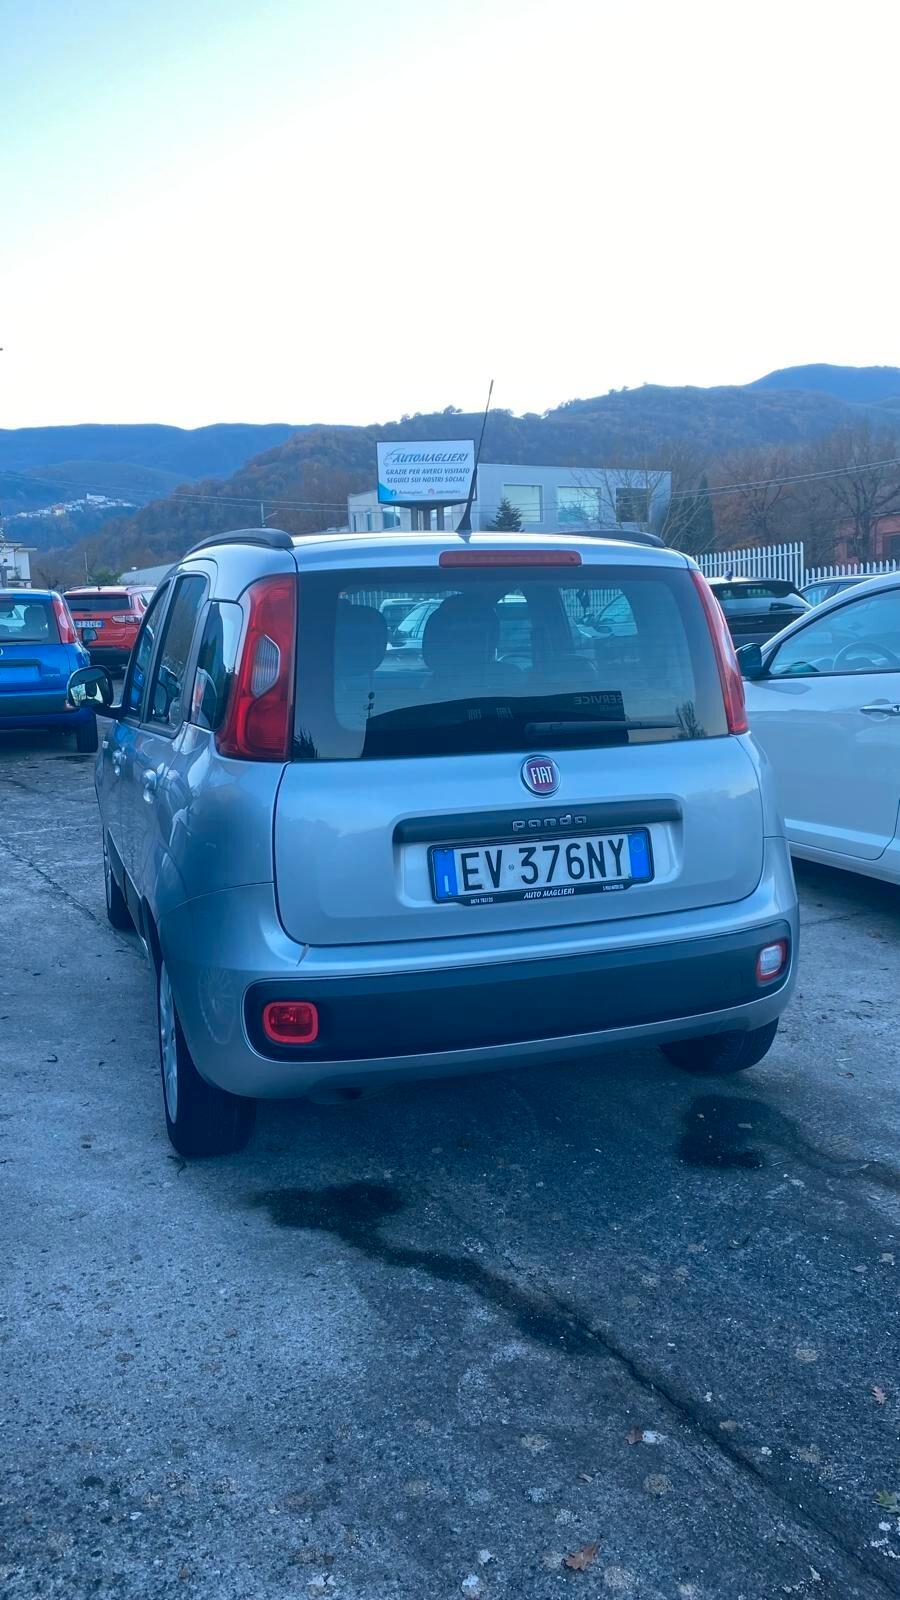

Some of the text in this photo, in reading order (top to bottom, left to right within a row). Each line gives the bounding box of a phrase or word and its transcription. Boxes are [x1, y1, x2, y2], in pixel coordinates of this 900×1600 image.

[392, 452, 469, 463] AUTOMAGLIERI
[530, 766, 553, 785] FIAT
[512, 815, 587, 831] panda
[460, 838, 624, 891] EV 376NY
[523, 887, 575, 899] AUTO MAGLIERI
